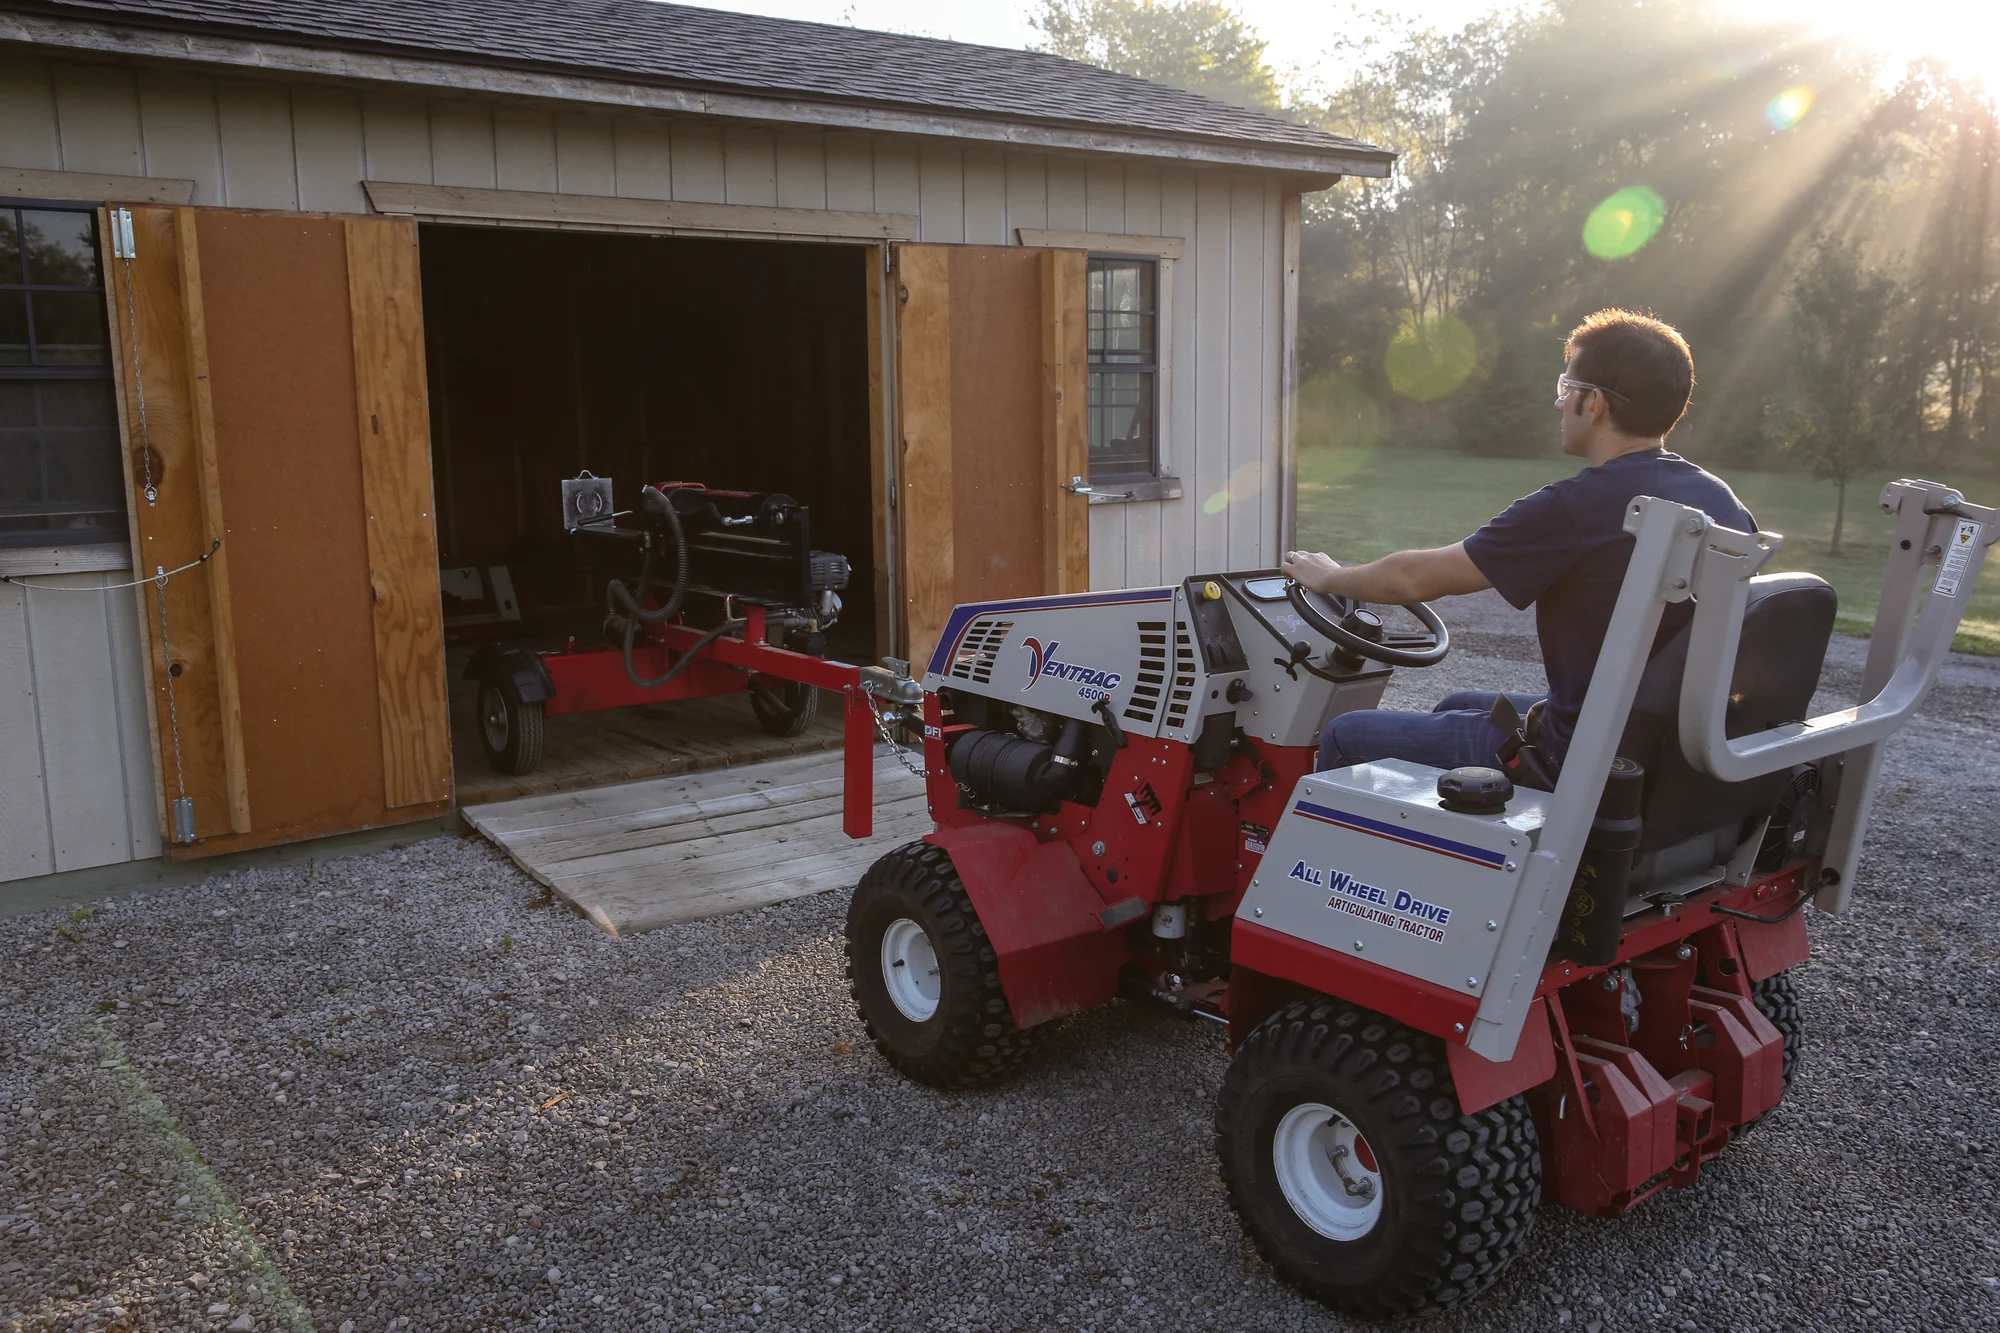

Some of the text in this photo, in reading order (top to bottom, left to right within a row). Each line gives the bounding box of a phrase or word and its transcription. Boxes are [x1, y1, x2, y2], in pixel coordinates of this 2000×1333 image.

[1021, 637, 1121, 691] VENTRAC
[1326, 896, 1445, 944] ARTICULATING TRACTOR
